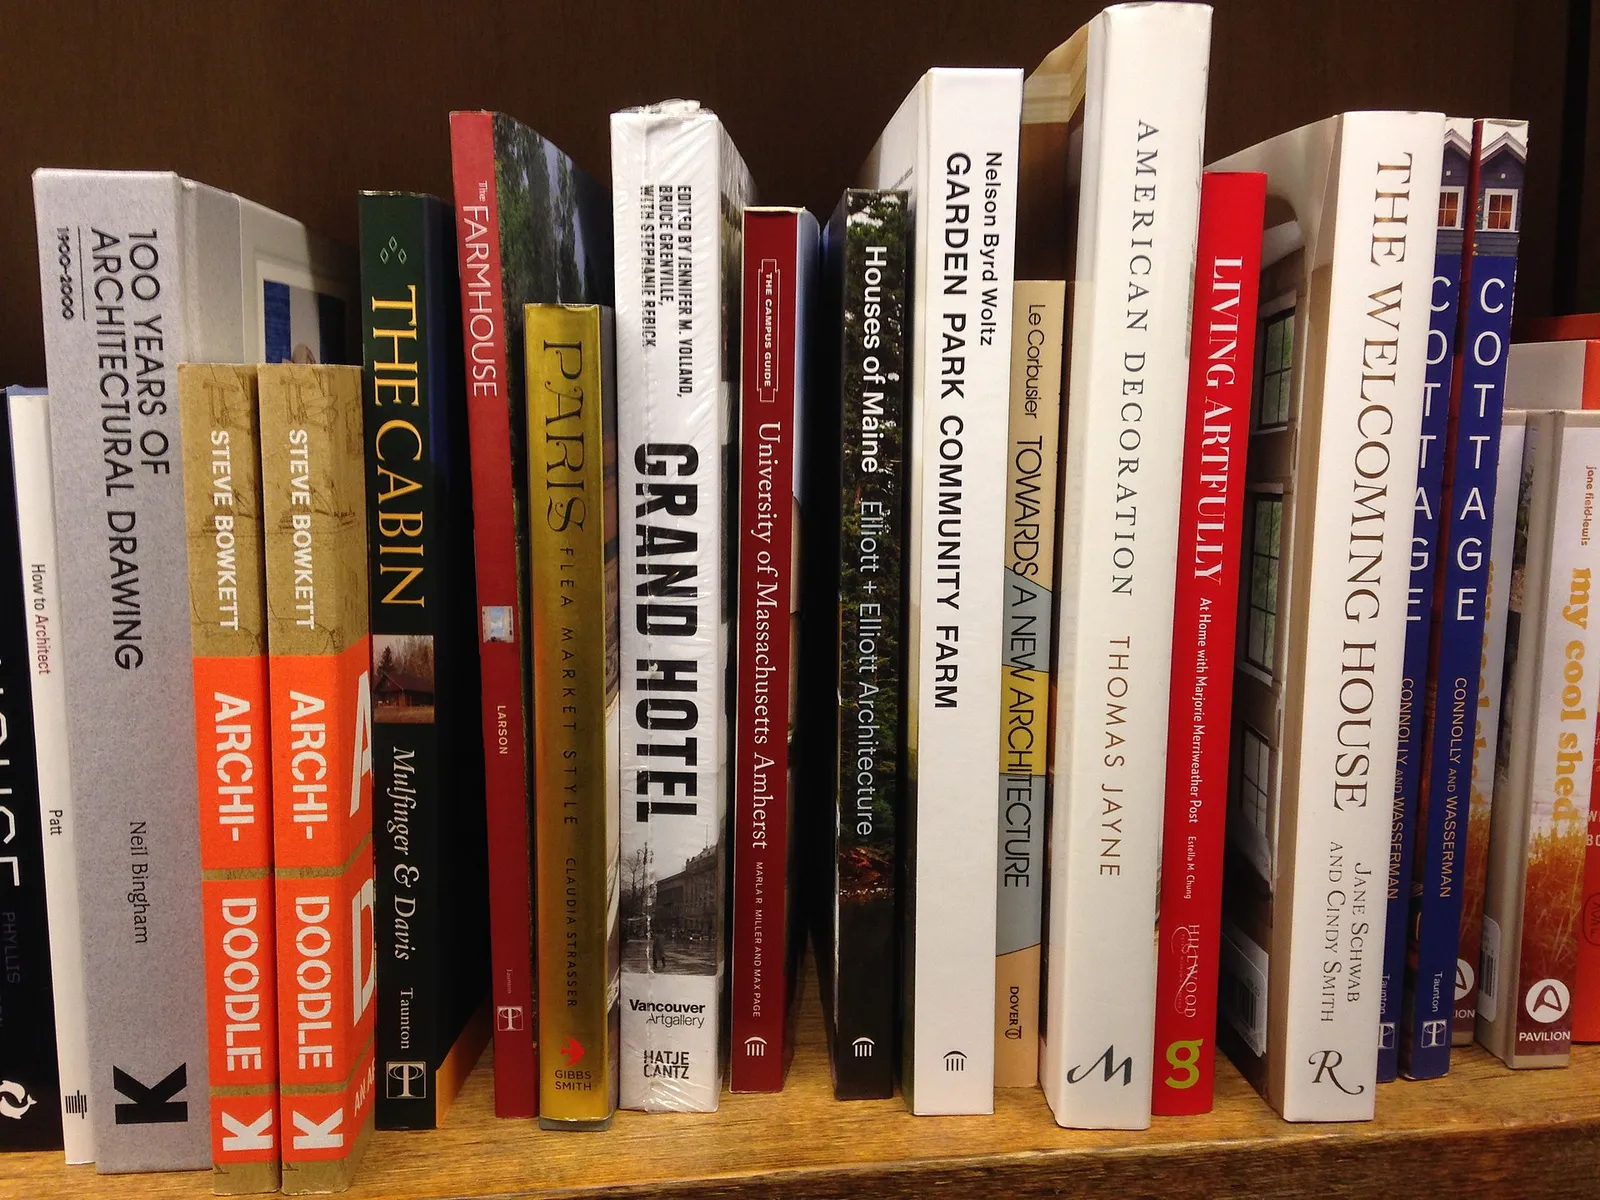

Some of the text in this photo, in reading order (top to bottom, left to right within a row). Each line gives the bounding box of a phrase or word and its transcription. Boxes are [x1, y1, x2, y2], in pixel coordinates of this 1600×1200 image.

[640, 184, 655, 219] WITH
[658, 185, 674, 306] BRUCE GRENVILLE,
[677, 185, 692, 230] EDITED
[678, 235, 692, 253] BY
[56, 226, 75, 321] 1900-2000
[641, 224, 656, 296] STEPHANIE
[678, 256, 693, 315] JENNIFER
[979, 152, 1003, 347] Nelson Byrd Woltz
[463, 205, 498, 398] FARMHOUSE
[763, 271, 773, 387] THE CAMPUS GUIDE
[863, 246, 887, 350] Houses
[129, 228, 170, 475] 100 YEARS OF
[677, 338, 693, 398] VOLLAND,
[862, 355, 886, 385] of
[91, 226, 144, 670] ARCHITECTURAL DRAWING
[371, 284, 425, 608] THE CABIN
[861, 391, 885, 474] Maine
[934, 152, 972, 709] GARDEN PARK COMMUNITY FARM
[1193, 256, 1243, 586] LIVING ARTFULLY
[1456, 277, 1506, 621] COTTAGE
[1099, 119, 1160, 876] AMERICAN DECORATION THOMAS JAYNE
[1333, 151, 1413, 812] THE WELCOMING HOUSE
[1581, 465, 1597, 546] jane field-lewis
[210, 430, 239, 631] STEVE BOWKETT
[288, 428, 316, 629] STEVE BOWKETT
[860, 500, 882, 573] Elliott
[31, 563, 51, 675] How to Architect
[542, 339, 585, 825] PARIS FLEA MARKET STYLE
[1004, 304, 1046, 888] Le Corbusier TOWARDS A NEW ARCHITECTURE
[634, 442, 700, 823] GRAND HOTEL
[751, 421, 781, 850] University of Massachusetts Amherst
[859, 602, 882, 673] Elliott
[496, 704, 508, 755] LARSON
[1188, 597, 1213, 824] At Home with Marjorie Merriweather Post
[1553, 567, 1593, 822] my cool shed
[214, 691, 255, 842] ARCHI-
[289, 690, 328, 840] ARCHI-
[856, 681, 880, 836] Architecture
[1394, 768, 1404, 794] AND
[1439, 677, 1468, 898] CONNOLLY AND WASSERMAN
[49, 809, 63, 836] Patt
[387, 746, 421, 961] Mulfinger & Davis
[1187, 835, 1197, 862] Estella
[1328, 841, 1344, 883] AND
[1387, 797, 1406, 899] WASSERMAN
[127, 821, 149, 944] Neil Bingham
[755, 861, 764, 895] MARLA
[1183, 874, 1195, 900] Chung
[2, 911, 21, 984] PHYLLIS
[565, 857, 578, 1007] CLAUDIA STRASSER
[754, 909, 763, 945] MILLER
[754, 946, 762, 967] AND
[221, 897, 263, 1072] DOODLE
[294, 895, 334, 1070] DOODLE
[400, 988, 415, 1050] Taunton
[628, 998, 706, 1014] Vancouver
[646, 1012, 705, 1029] Artgallery
[752, 992, 761, 1018] PAGE
[753, 968, 762, 991] MAX
[1009, 986, 1019, 1026] DOVER
[1431, 971, 1444, 1013] Taunton
[554, 1069, 592, 1081] GIBBS
[643, 1049, 690, 1066] HATJE
[643, 1064, 690, 1080] CANTZ
[1518, 1031, 1571, 1043] PAVILION
[554, 1081, 592, 1092] SMITH
